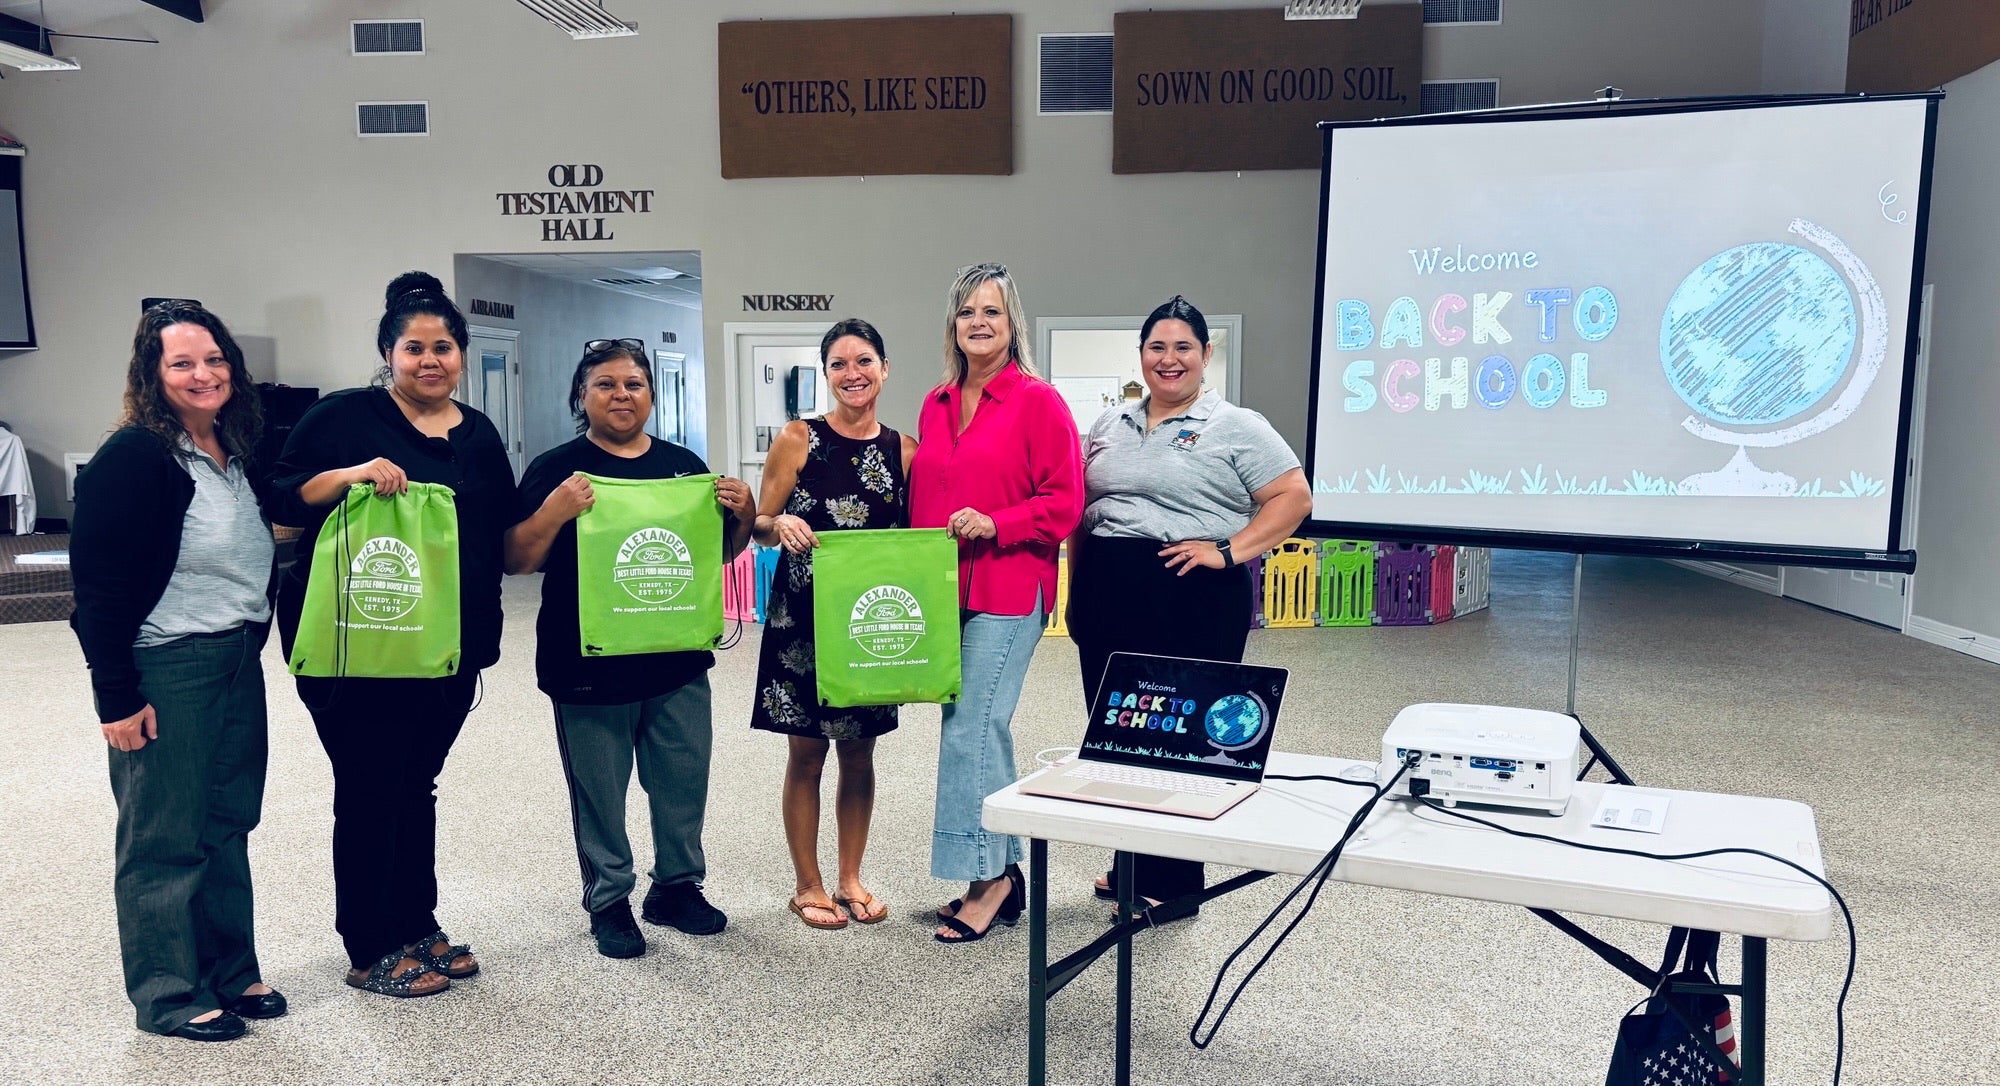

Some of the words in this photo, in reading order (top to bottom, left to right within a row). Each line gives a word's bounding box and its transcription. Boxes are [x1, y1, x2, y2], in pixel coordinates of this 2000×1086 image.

[863, 77, 918, 112] LIKE
[924, 76, 987, 111] SEED
[1137, 70, 1211, 106] SOWN
[1220, 69, 1256, 104] ON
[1263, 67, 1334, 103] GOOD
[1343, 66, 1407, 105] SOIL,
[547, 164, 604, 187] OLD
[496, 190, 654, 215] TESTAMENT
[541, 218, 614, 241] HALL
[1408, 244, 1539, 275] Welcome
[742, 294, 835, 311] NURSERY
[1335, 290, 1513, 350] BACK
[1524, 286, 1619, 343] TO
[1342, 352, 1608, 413] SCHOOL
[620, 529, 687, 558] ALEXANDER
[643, 550, 665, 561] Ford
[356, 539, 419, 573] ALEXANDER
[372, 560, 398, 574] Ford
[382, 605, 400, 613] 1975
[855, 587, 918, 616] ALEXANDER
[876, 606, 897, 617] Ford
[382, 623, 398, 631] local
[1138, 680, 1177, 693] Welcome
[1107, 691, 1166, 712] BACK
[1169, 698, 1196, 715] TO
[1104, 709, 1188, 734] SCHOOL
